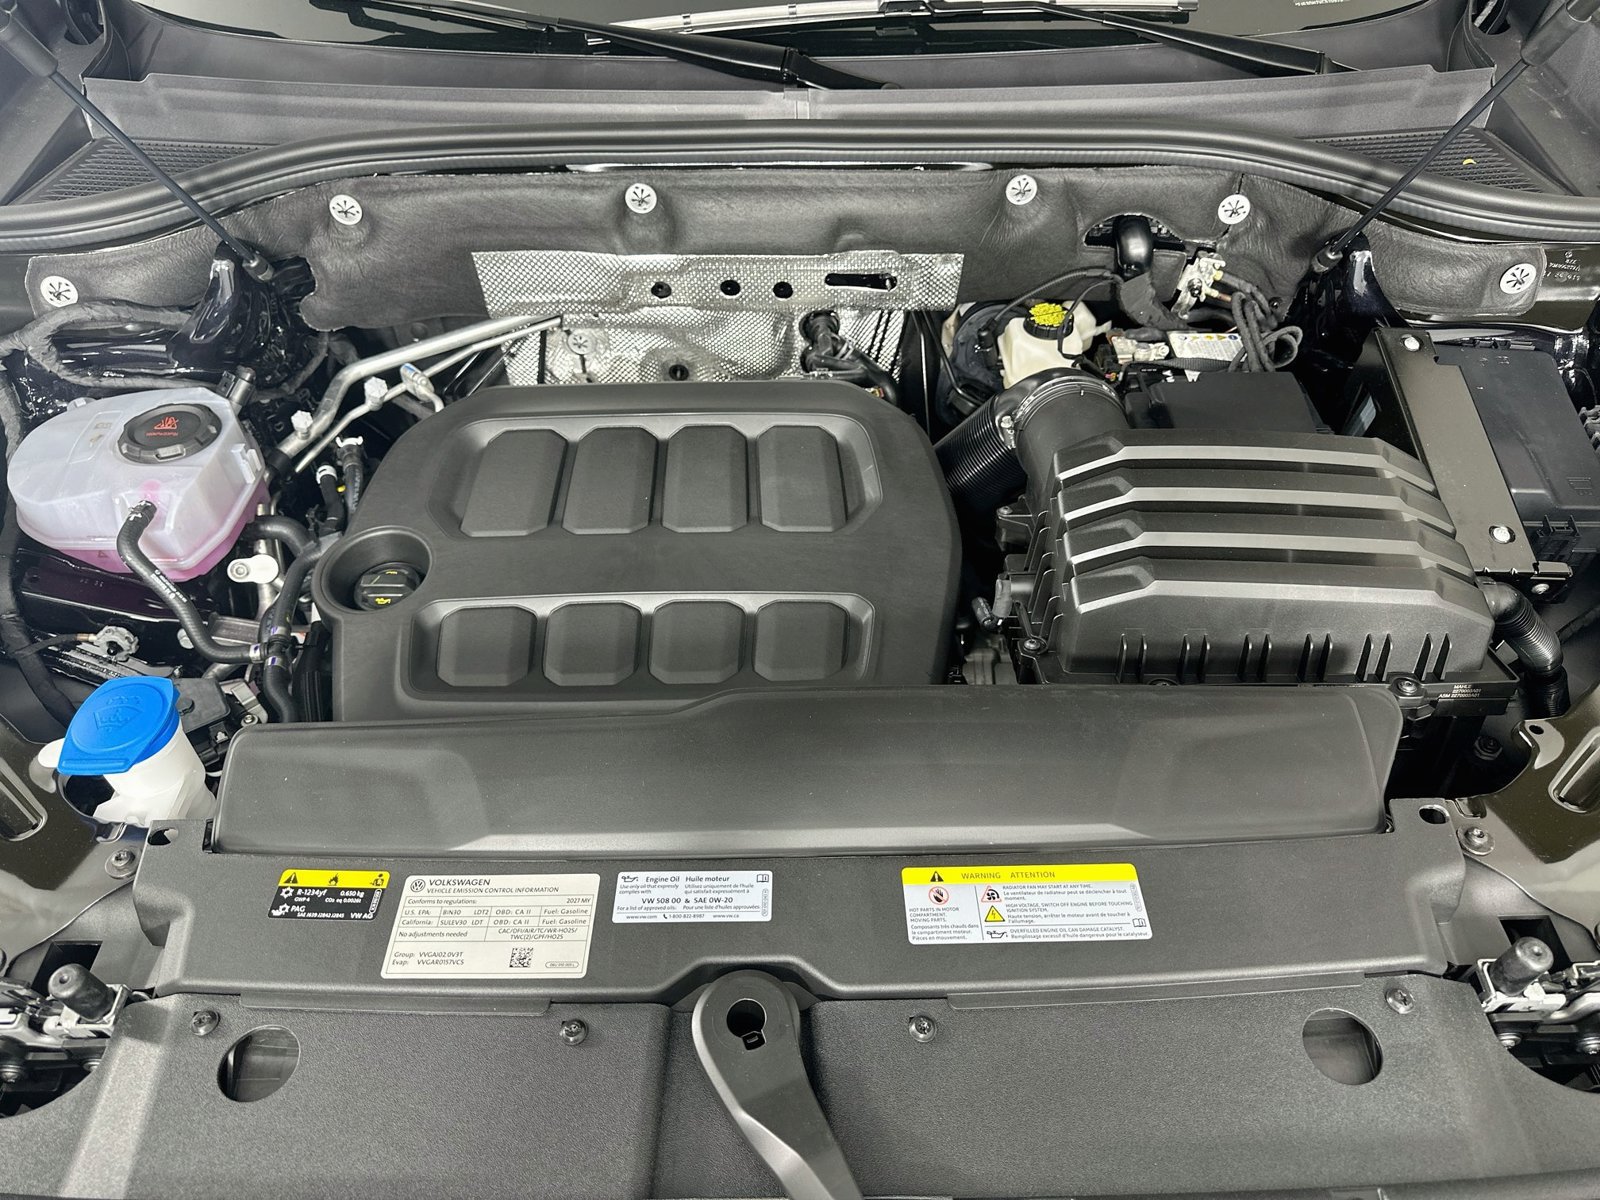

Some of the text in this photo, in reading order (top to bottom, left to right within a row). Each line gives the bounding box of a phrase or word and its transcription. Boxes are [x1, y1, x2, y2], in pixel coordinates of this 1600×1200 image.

[428, 878, 490, 886] VOLKSWAGEN
[645, 876, 669, 884] Engine
[296, 888, 328, 898] R-1234yf
